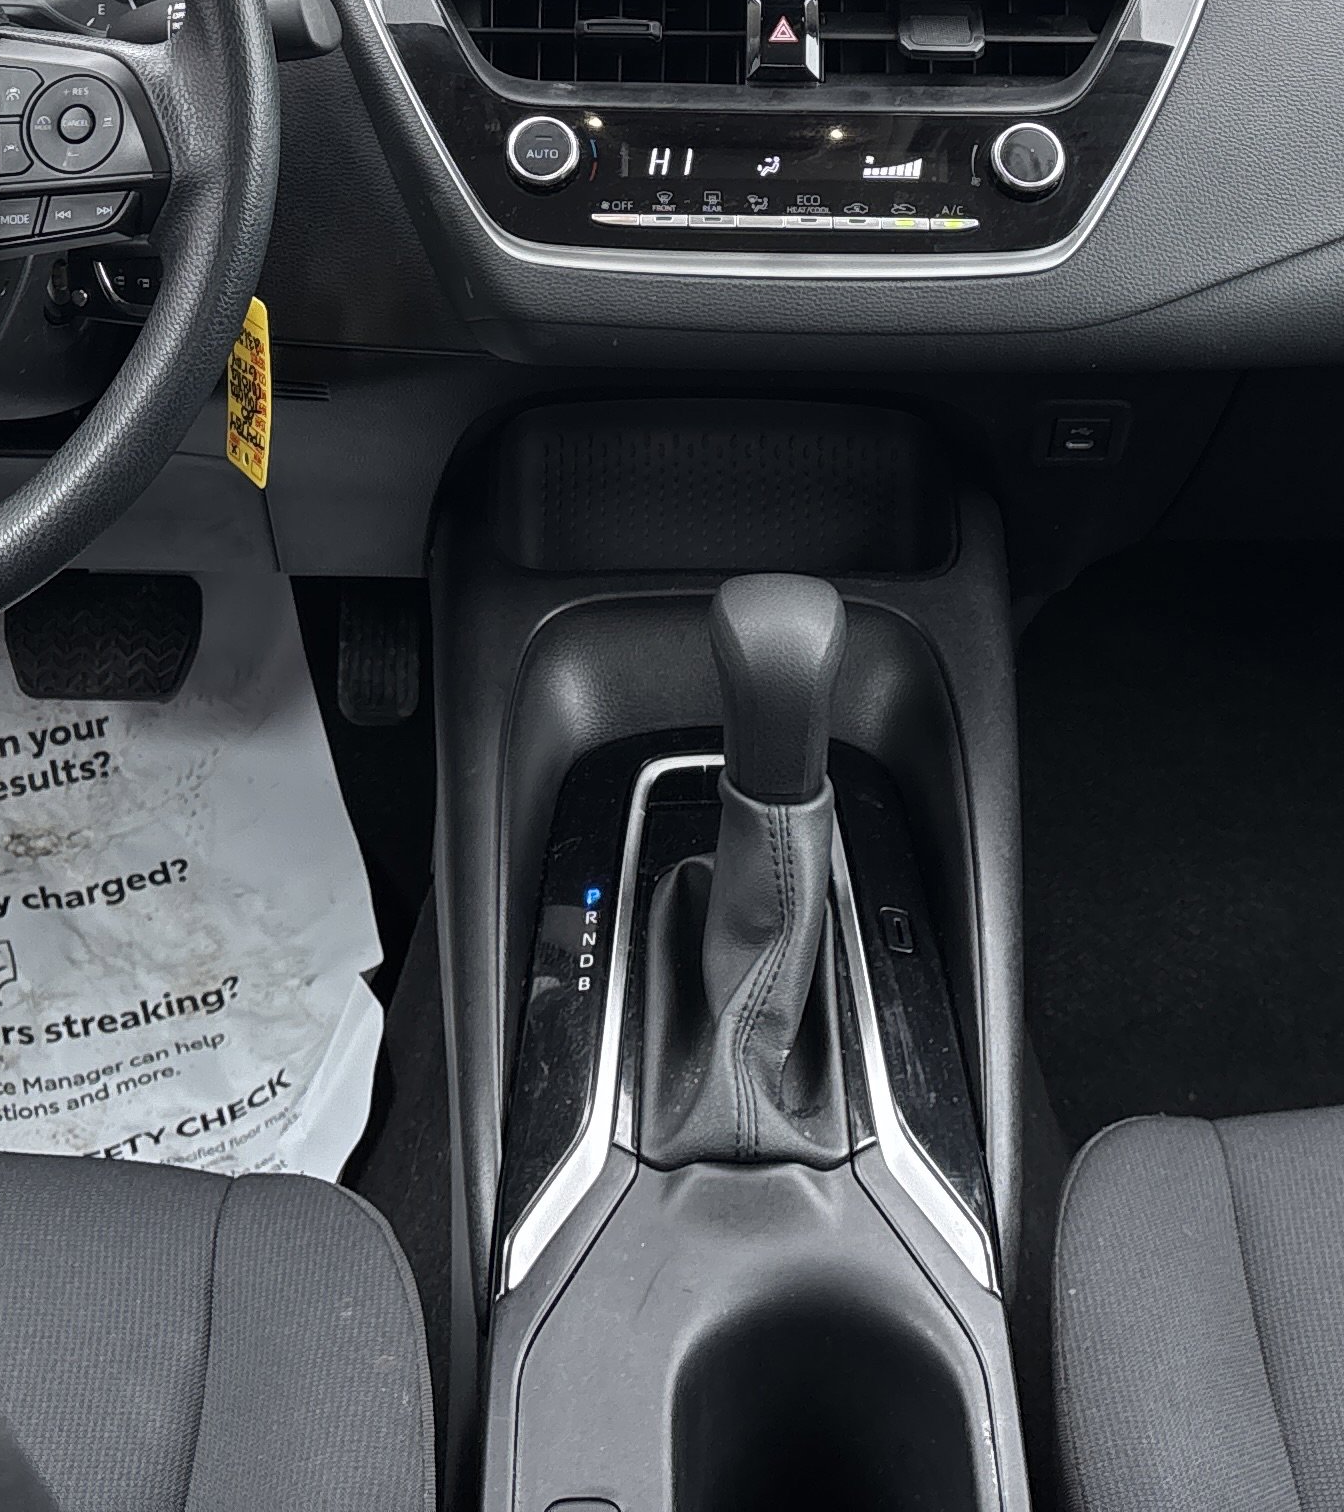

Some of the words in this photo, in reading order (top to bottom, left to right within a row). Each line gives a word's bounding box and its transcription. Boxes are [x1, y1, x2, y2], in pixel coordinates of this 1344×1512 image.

[98, 3, 106, 16] E
[72, 87, 90, 96] RES
[62, 119, 89, 128] CANCEL
[525, 149, 559, 159] AUTO
[611, 201, 634, 211] OFF
[796, 194, 821, 207] ECO
[652, 204, 677, 213] FRONT
[702, 204, 723, 213] REAR
[787, 206, 832, 214] HEAT/COOL
[941, 204, 964, 216] A/C
[0, 213, 30, 225] MODE
[29, 715, 111, 759] your
[21, 858, 190, 912] charged?
[587, 889, 601, 905] P
[585, 910, 598, 925] R
[582, 932, 597, 947] N
[579, 953, 594, 969] D
[578, 976, 591, 991] B
[43, 975, 241, 1045] streaking?
[21, 1060, 125, 1095] Manager
[128, 1046, 170, 1069] can
[173, 1031, 227, 1057] help
[67, 1086, 111, 1112] and
[116, 1065, 182, 1095] more.
[175, 1068, 293, 1138] CHECK
